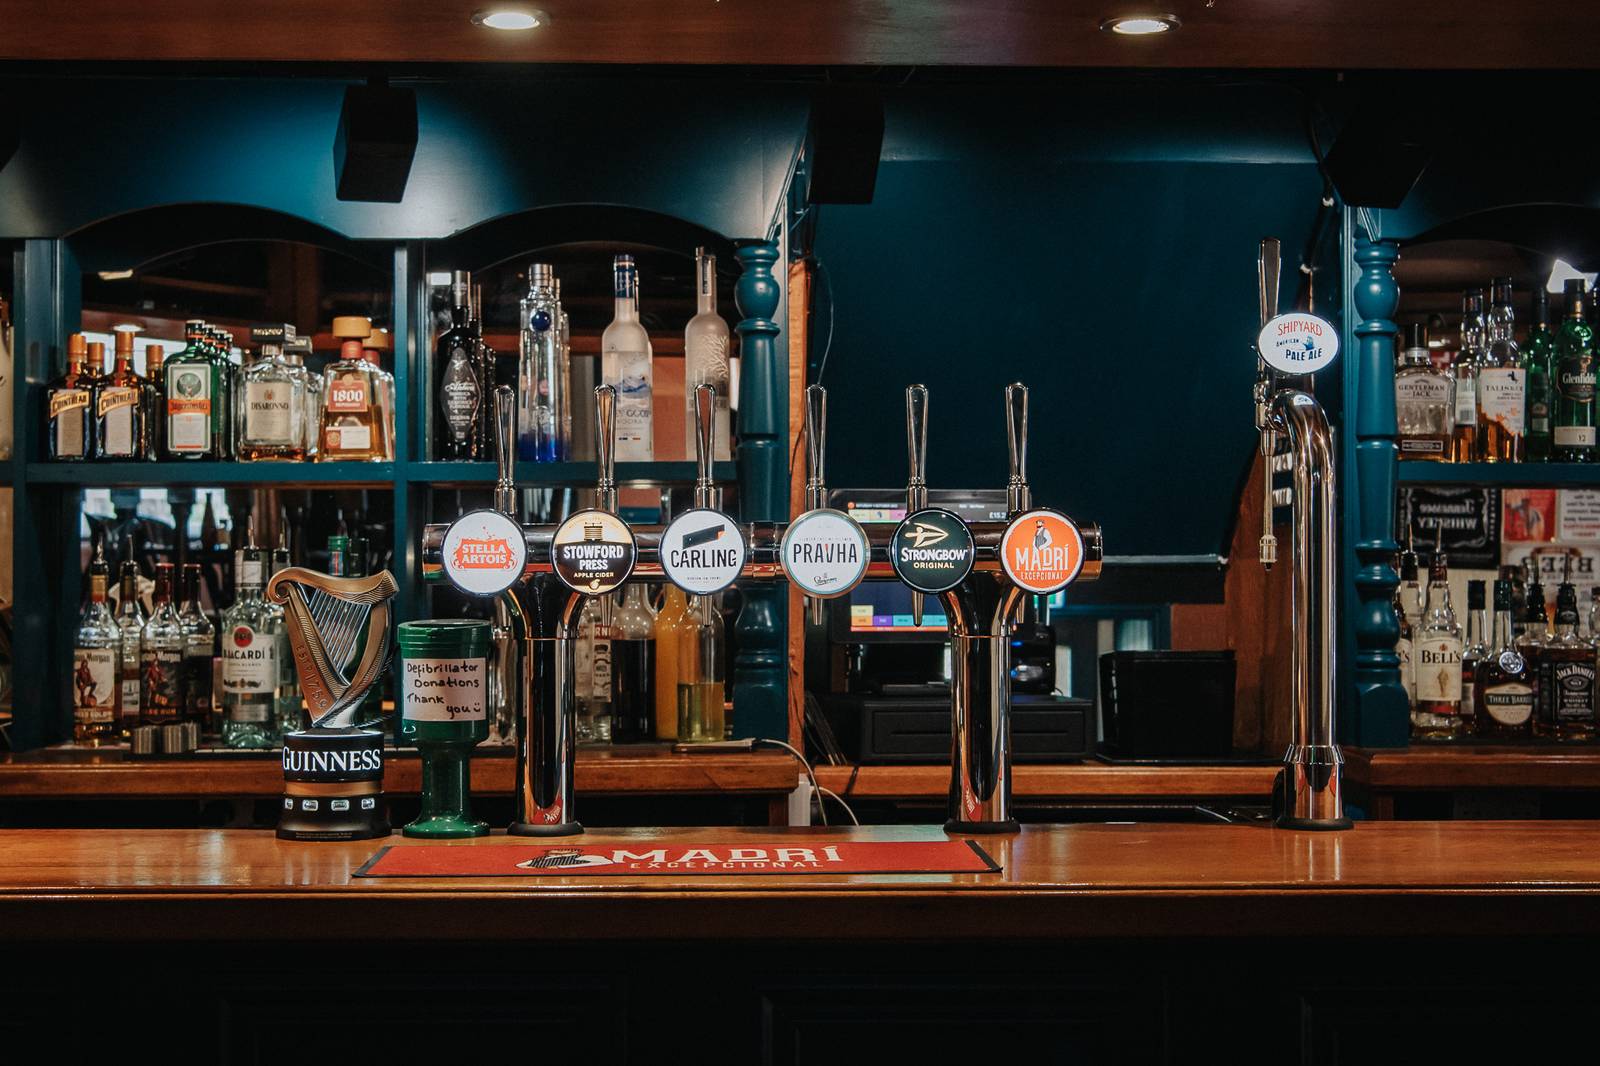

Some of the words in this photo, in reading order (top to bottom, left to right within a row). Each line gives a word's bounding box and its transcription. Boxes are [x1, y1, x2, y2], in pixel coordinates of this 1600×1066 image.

[1278, 320, 1322, 336] SHIPYARD
[1286, 349, 1305, 361] PALE
[1308, 348, 1322, 360] ALE
[333, 390, 363, 401] 1800
[251, 402, 289, 410] DISARONNO
[989, 511, 1007, 519] £15.2
[462, 543, 507, 554] STELLA
[563, 545, 624, 559] STOWFORD
[793, 543, 858, 563] PRAVHA
[462, 554, 507, 564] ARTOIS
[671, 550, 737, 568] CARLING
[901, 548, 966, 562] STRONGBOW
[1015, 544, 1069, 572] MADRÍ
[579, 560, 609, 570] PRESS
[913, 561, 955, 569] ORIGINAL
[1020, 571, 1063, 580] EXCEPCIONAL
[407, 660, 478, 678] Defibrillator
[415, 676, 480, 688] Donations
[406, 693, 445, 704] Thank
[446, 705, 471, 719] you
[282, 746, 381, 771] GUINNESS
[612, 845, 844, 863] MADRÍ
[630, 861, 823, 869] EXCEPCIONAL
